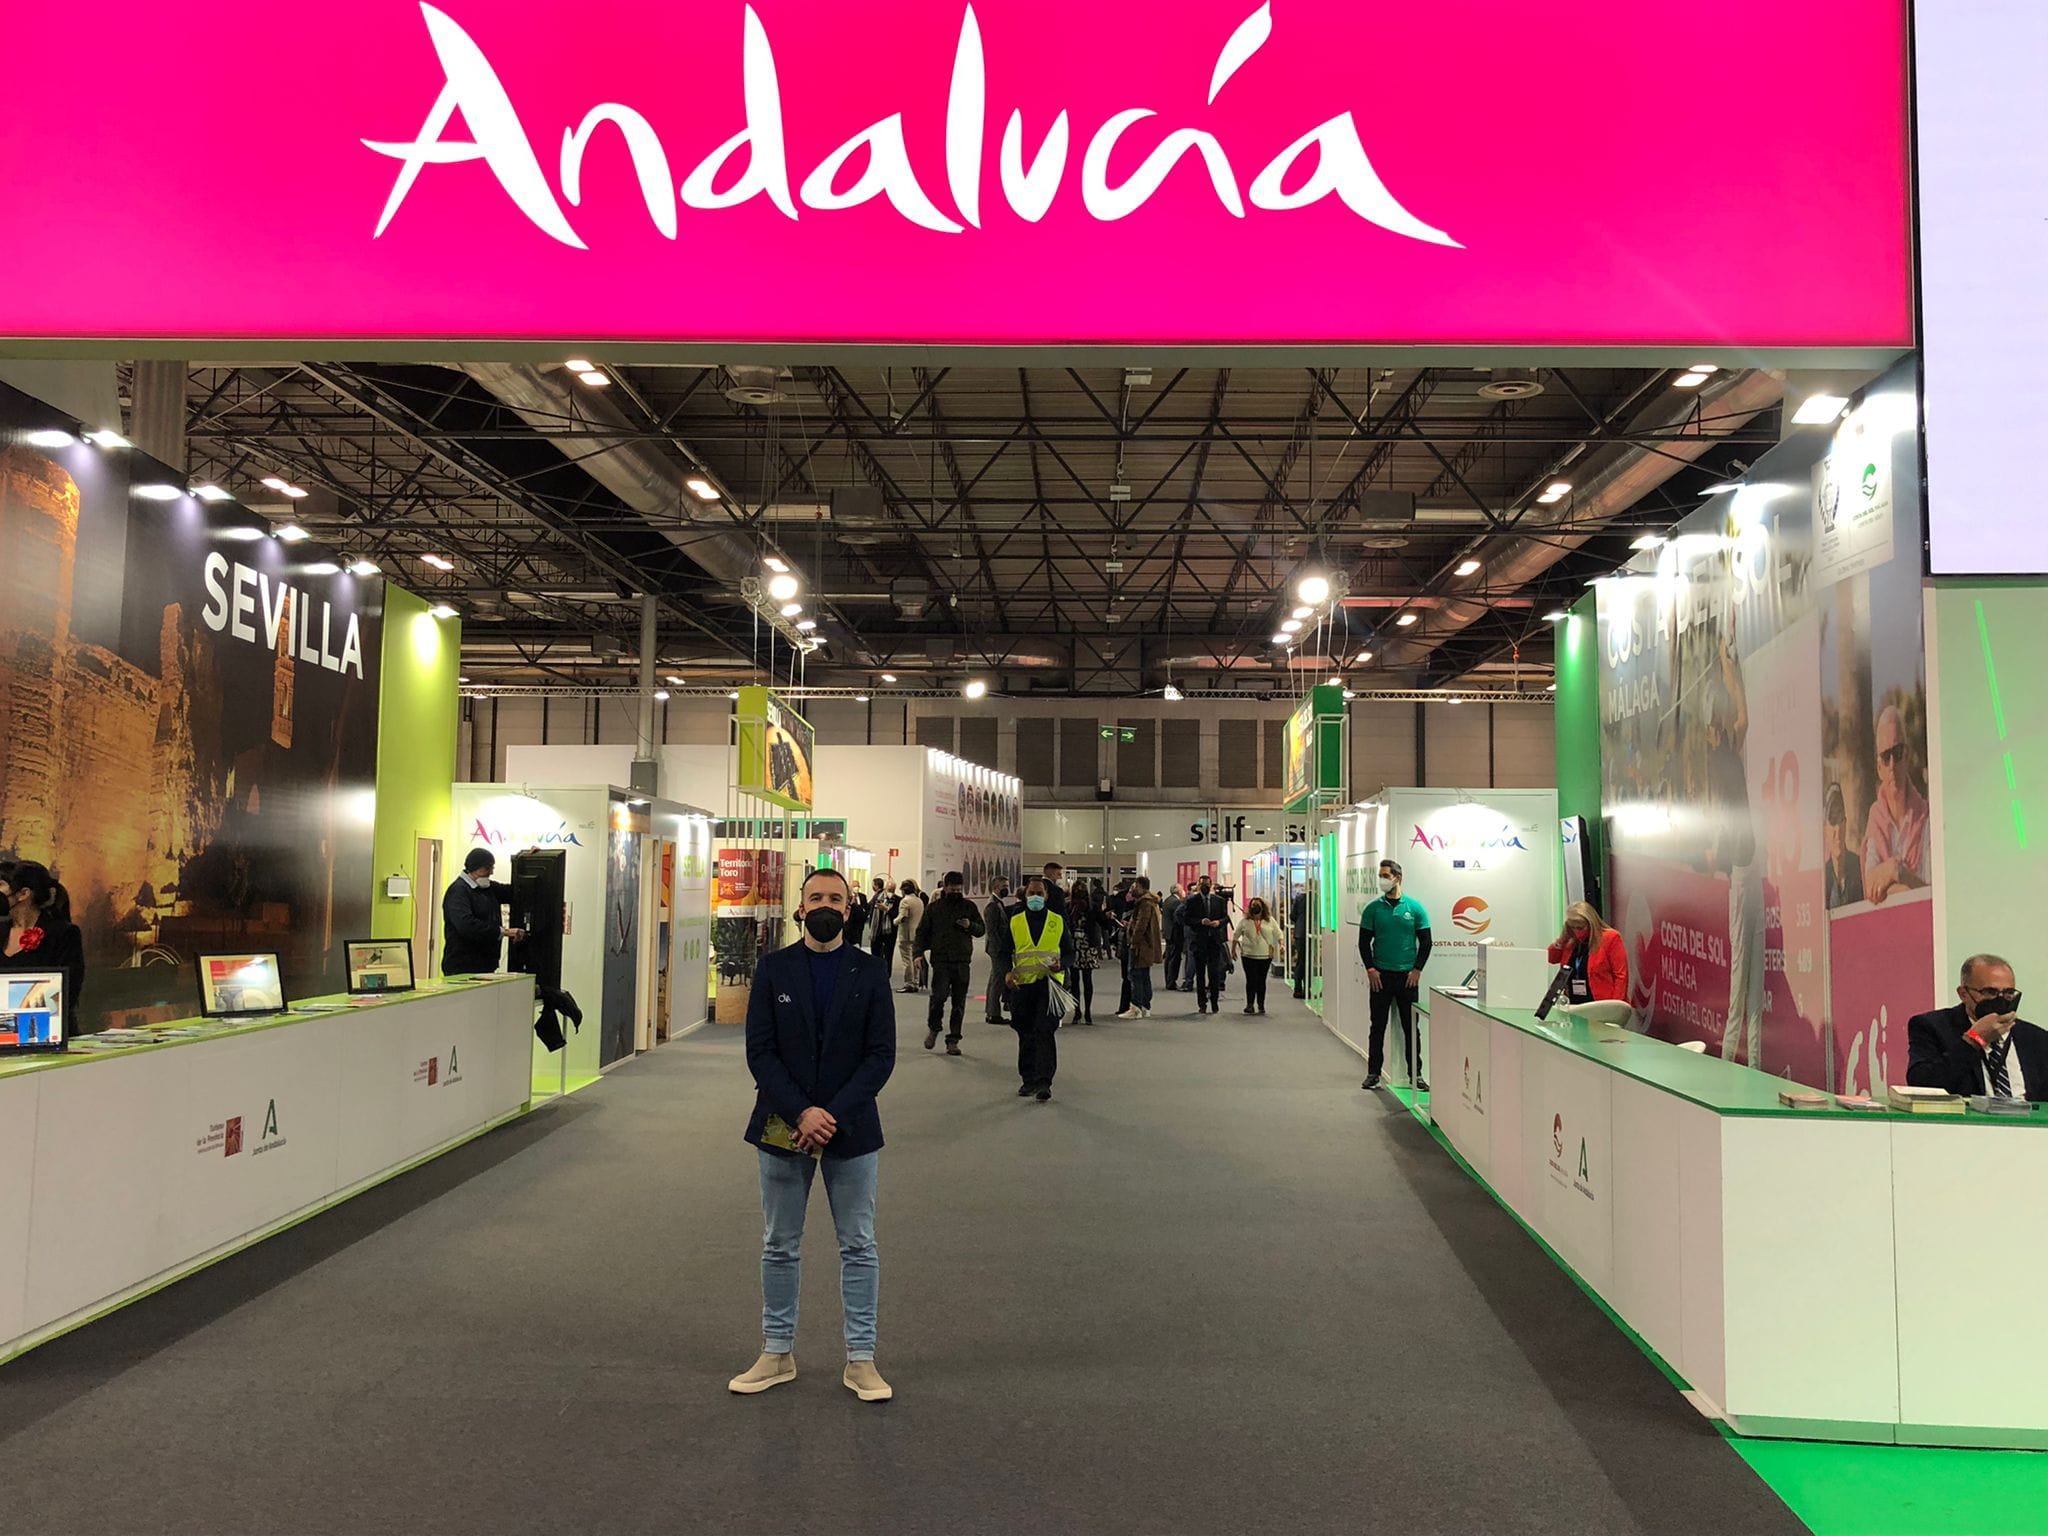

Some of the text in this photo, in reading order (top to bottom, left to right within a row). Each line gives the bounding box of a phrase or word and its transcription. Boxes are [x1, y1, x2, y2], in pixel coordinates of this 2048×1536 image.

[360, 1, 1466, 249] Andalucía
[202, 552, 364, 681] SEVILLA
[1608, 672, 1661, 724] MÁLAGA
[1190, 816, 1246, 842] self
[720, 867, 738, 877] Toro
[1661, 921, 1727, 967] COSTA DEL SOL
[1764, 949, 1786, 972] ETERS
[1661, 951, 1697, 991] MÁLAGA
[1663, 991, 1722, 1033] COSTA DEL GOLF
